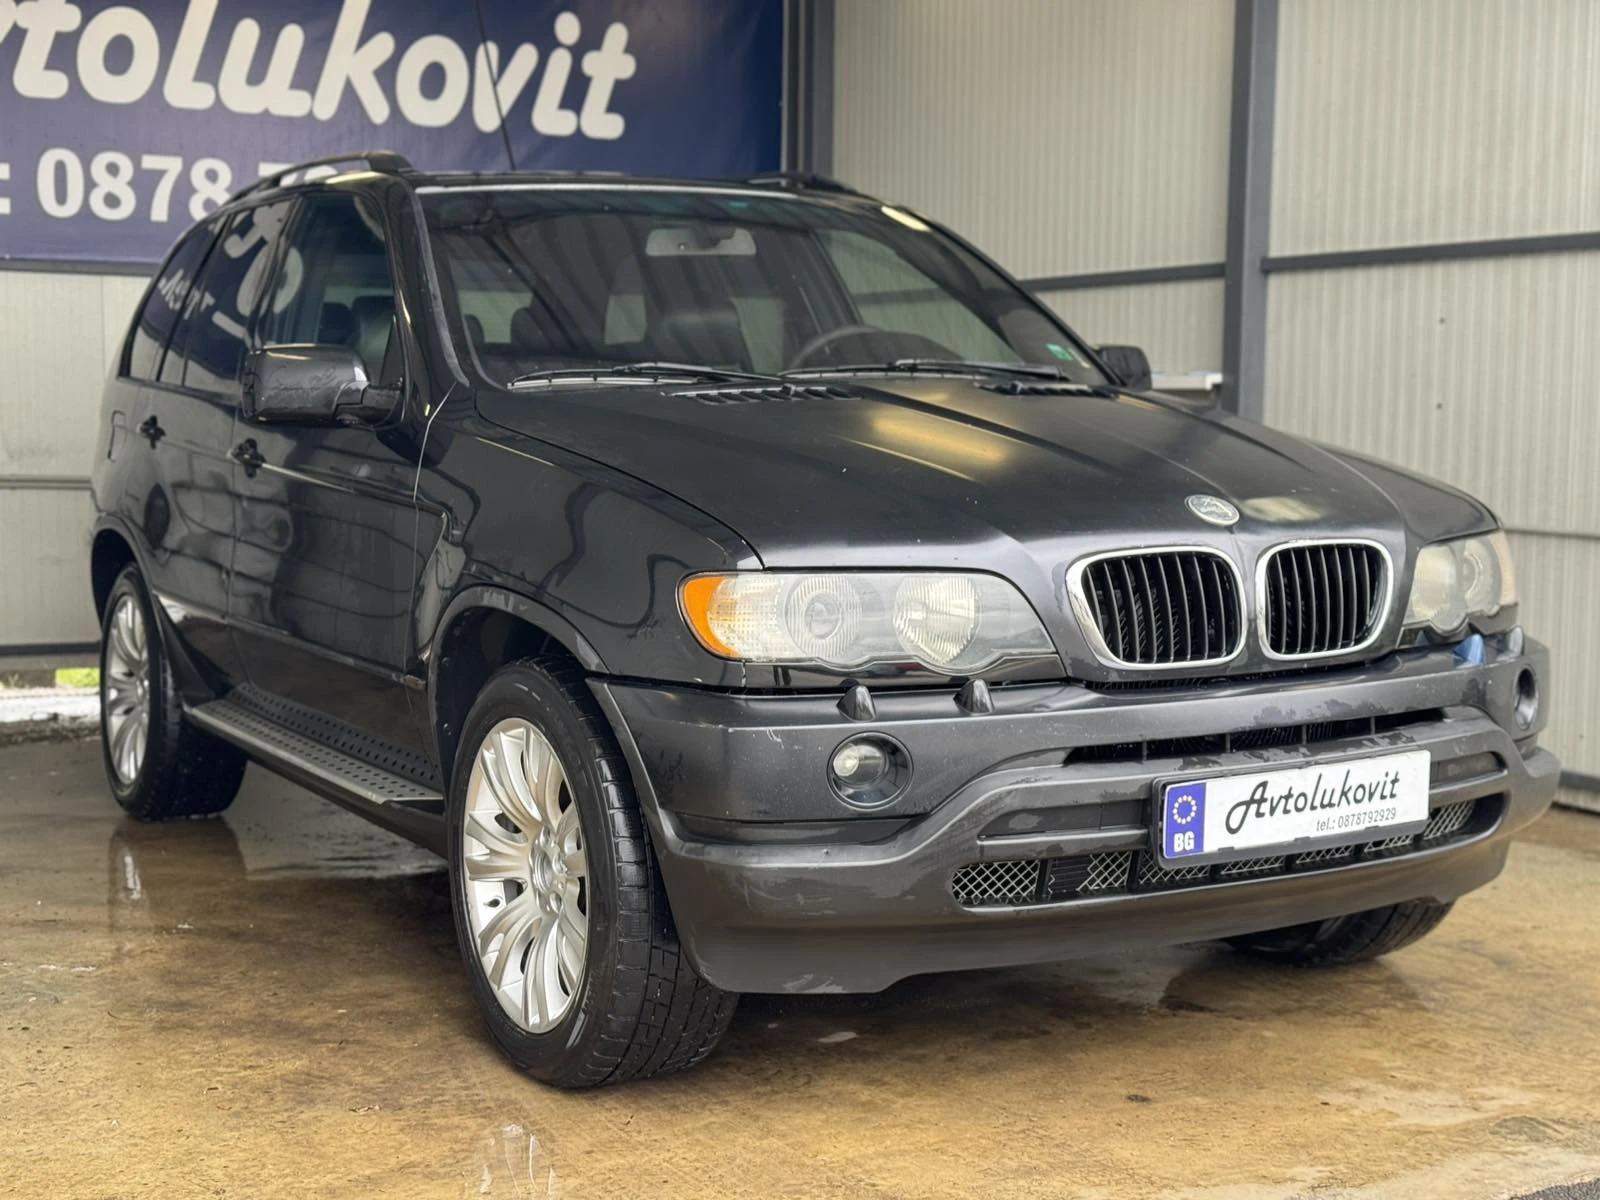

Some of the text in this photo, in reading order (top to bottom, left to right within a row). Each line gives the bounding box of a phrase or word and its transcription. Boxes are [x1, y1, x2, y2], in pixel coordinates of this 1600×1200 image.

[0, 0, 636, 139] tolukovit
[37, 147, 232, 222] 0878
[1225, 769, 1401, 835] Avtolukovit
[1316, 807, 1397, 832] tel.: 0878792929
[1174, 831, 1195, 852] BG
